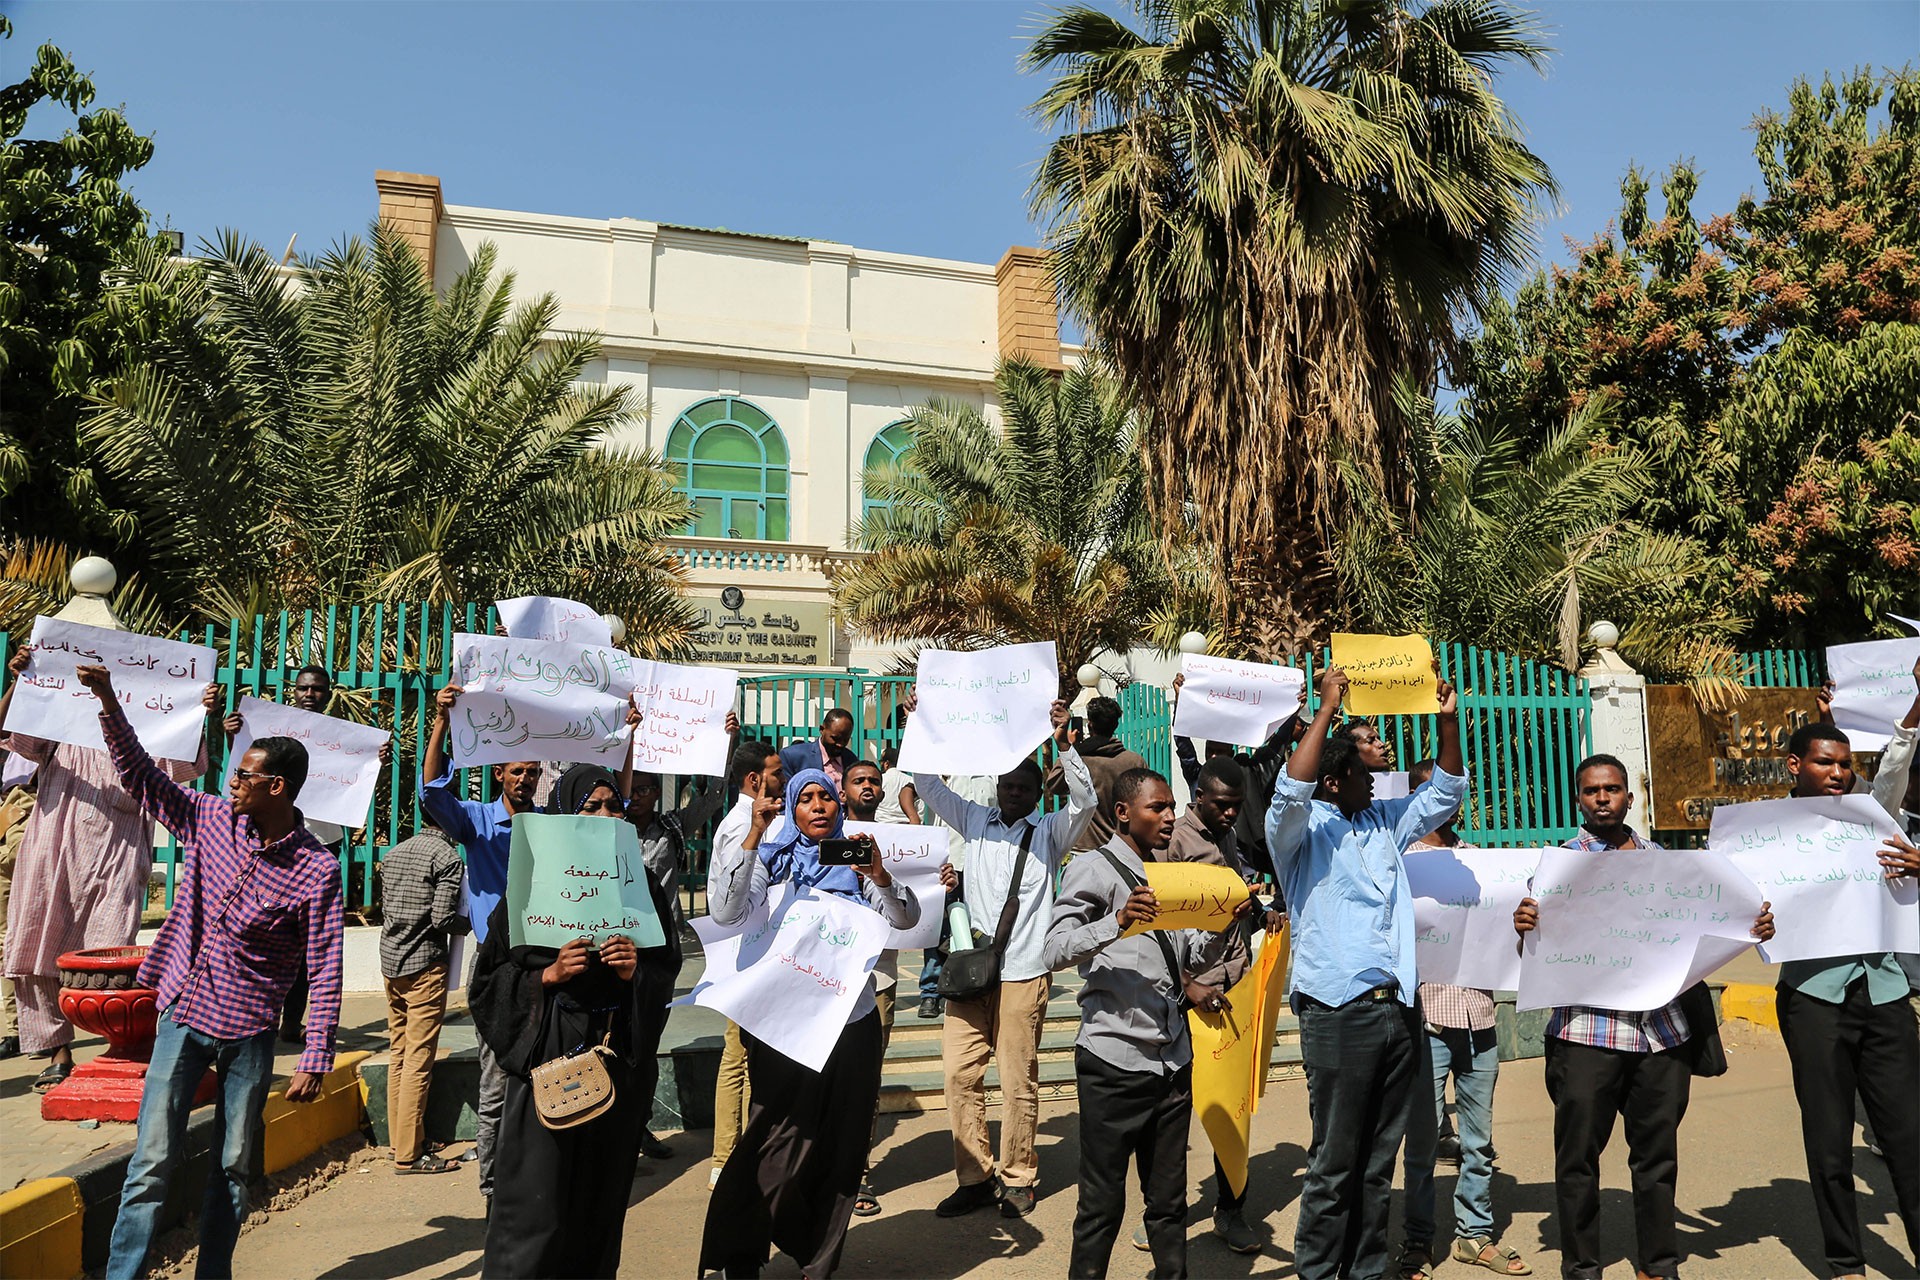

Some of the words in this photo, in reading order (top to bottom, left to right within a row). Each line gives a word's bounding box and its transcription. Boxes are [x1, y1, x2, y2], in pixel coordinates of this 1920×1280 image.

[715, 606, 757, 630] مجلس
[727, 631, 742, 645] OF
[747, 632, 768, 646] THE
[770, 633, 818, 649] CABINET
[668, 686, 716, 709] السلطة
[649, 707, 680, 722] مخولة
[686, 713, 707, 726] غير
[649, 720, 677, 738] قضايا
[560, 885, 599, 903] القرن
[1664, 881, 1722, 903] القضية
